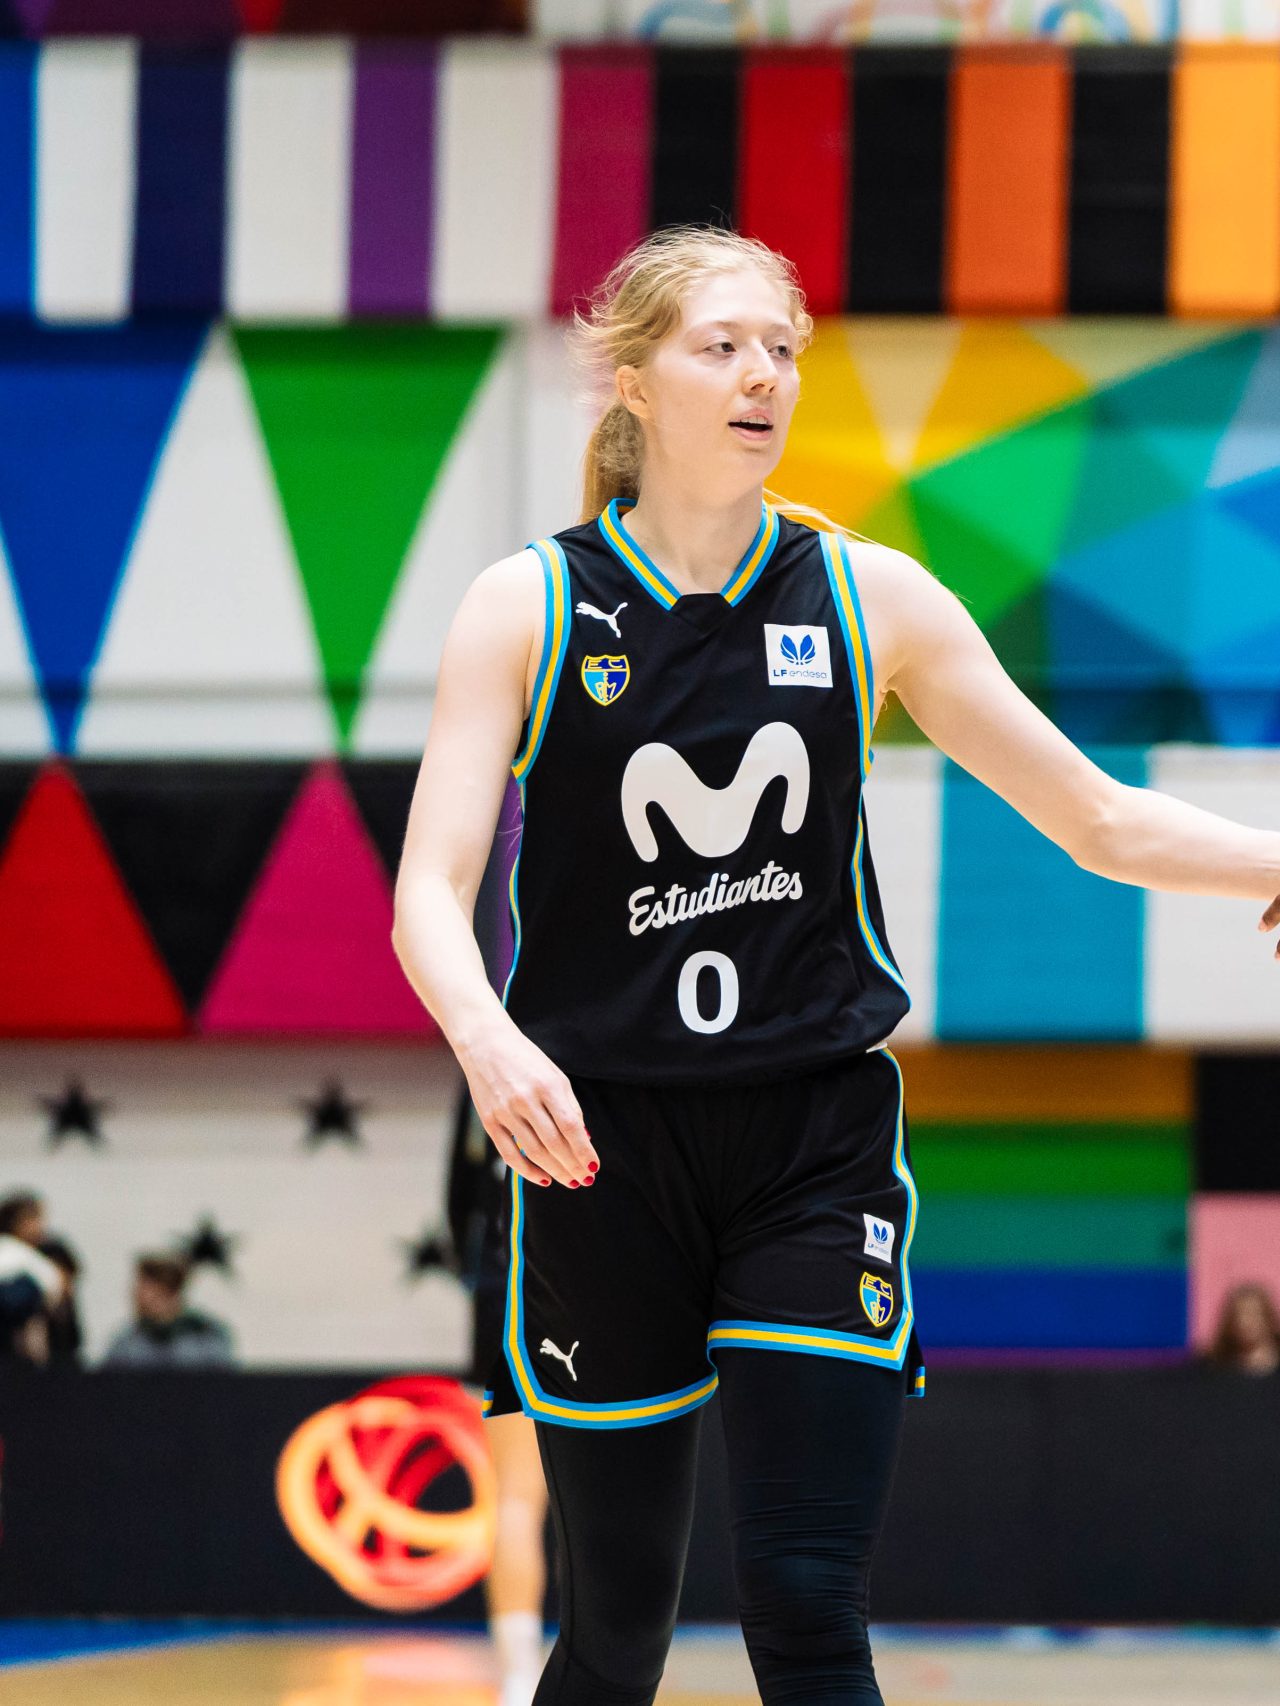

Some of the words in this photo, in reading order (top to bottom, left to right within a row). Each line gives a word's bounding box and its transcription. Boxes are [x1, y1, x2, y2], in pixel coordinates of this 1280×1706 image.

[773, 669, 787, 677] LF
[789, 669, 827, 679] endesa
[628, 860, 804, 936] Estudiantes
[677, 950, 740, 1035] 0
